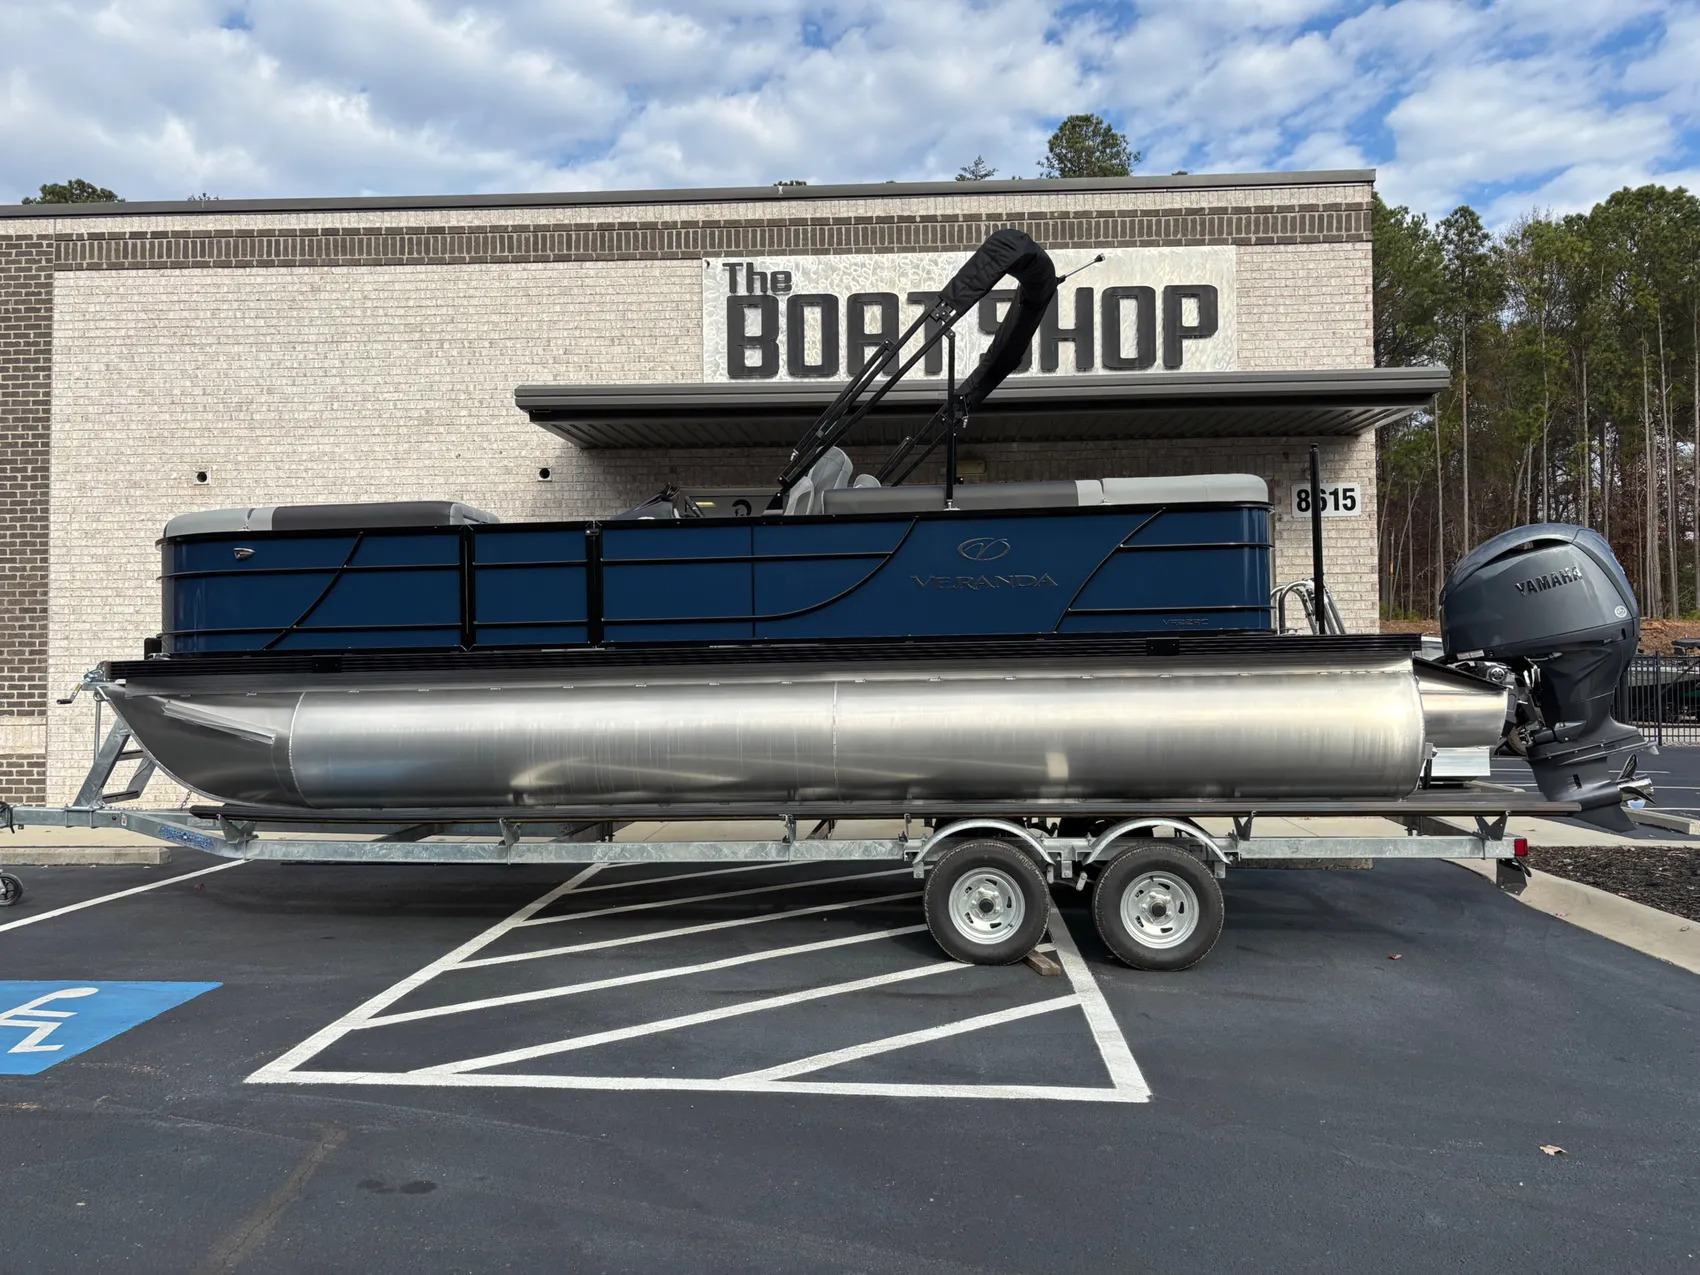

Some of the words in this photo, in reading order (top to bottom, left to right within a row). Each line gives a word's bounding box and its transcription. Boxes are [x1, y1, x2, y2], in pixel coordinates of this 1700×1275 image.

[722, 262, 792, 295] The
[727, 292, 957, 378] BOAT
[910, 573, 1058, 590] VERANDA
[1515, 566, 1583, 597] YAMAHA
